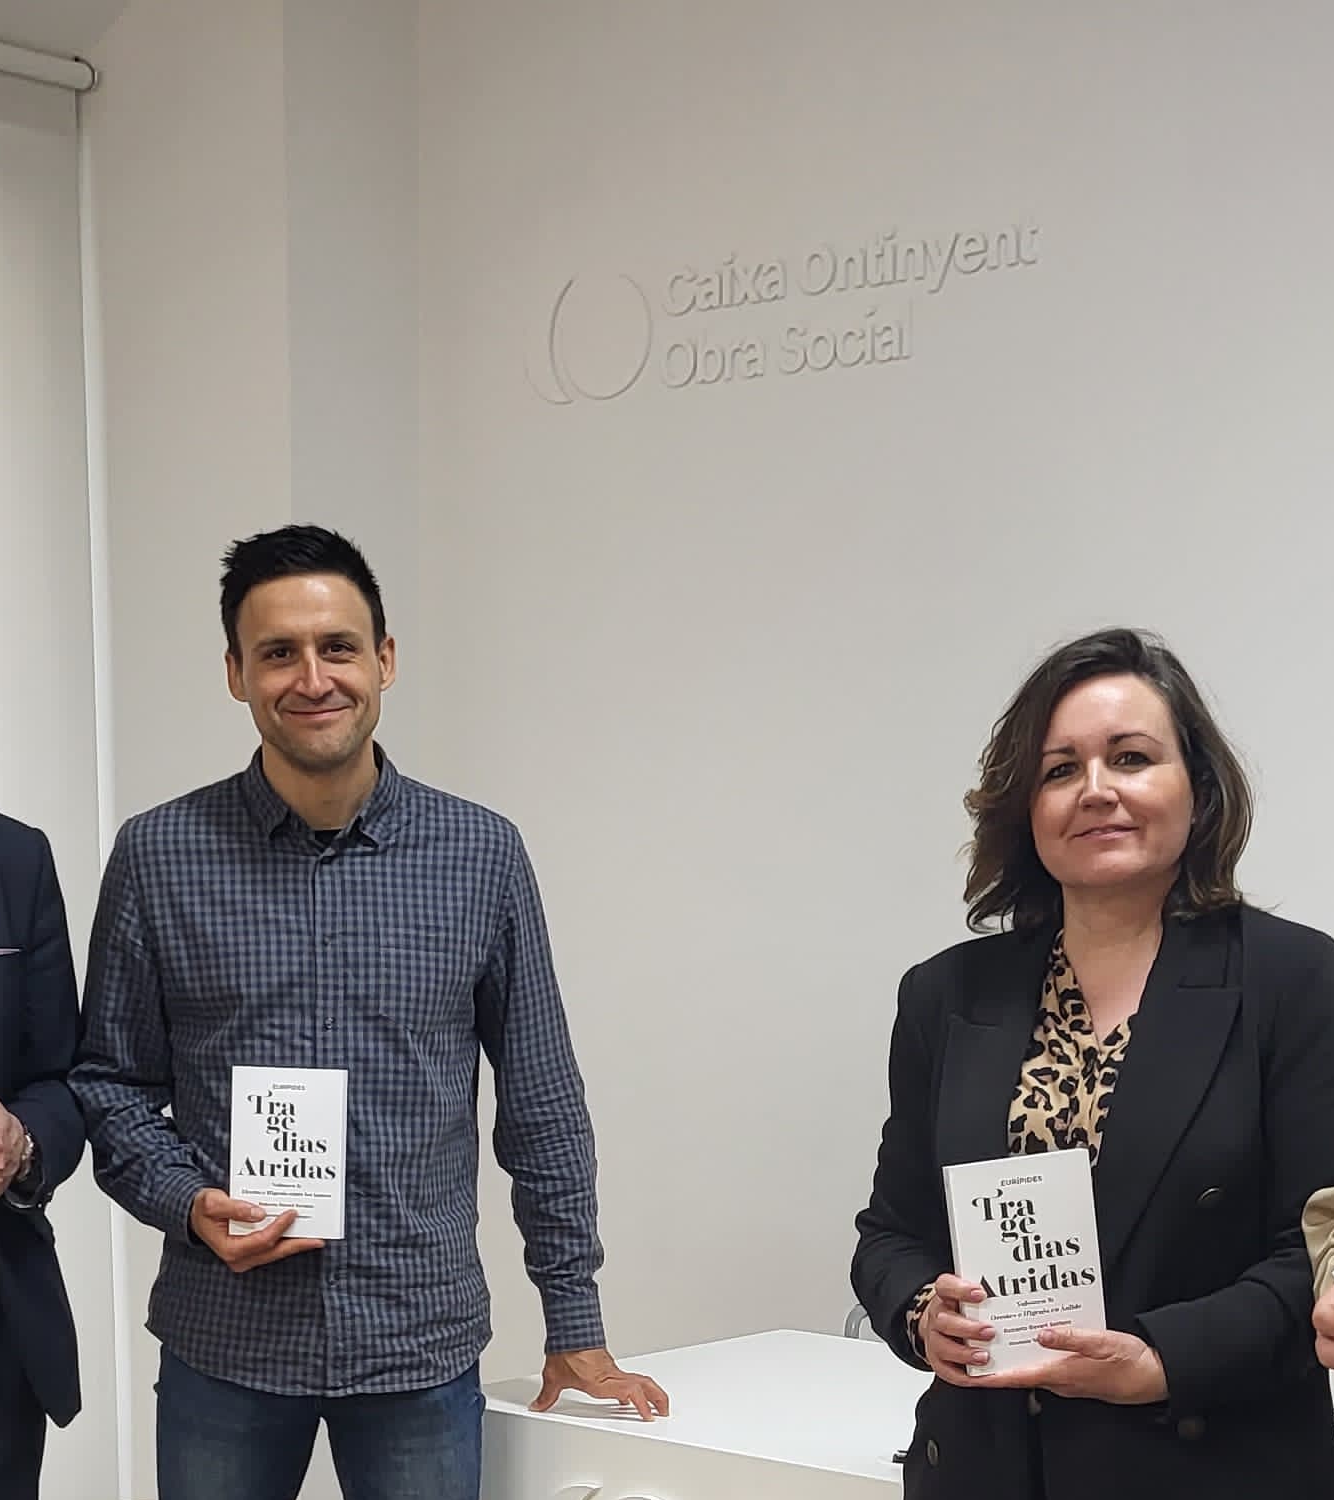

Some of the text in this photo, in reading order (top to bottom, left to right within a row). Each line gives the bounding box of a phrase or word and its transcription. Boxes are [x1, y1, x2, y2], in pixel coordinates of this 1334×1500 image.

[663, 221, 1042, 317] Caixa Ontinyent
[660, 301, 912, 389] Obra Social
[247, 1090, 295, 1116] Tra
[273, 1131, 328, 1153] dias
[236, 1156, 336, 1179] Atridas
[972, 1189, 1035, 1221] Tra
[1012, 1235, 1081, 1262] dias
[979, 1264, 1096, 1298] Atridas
